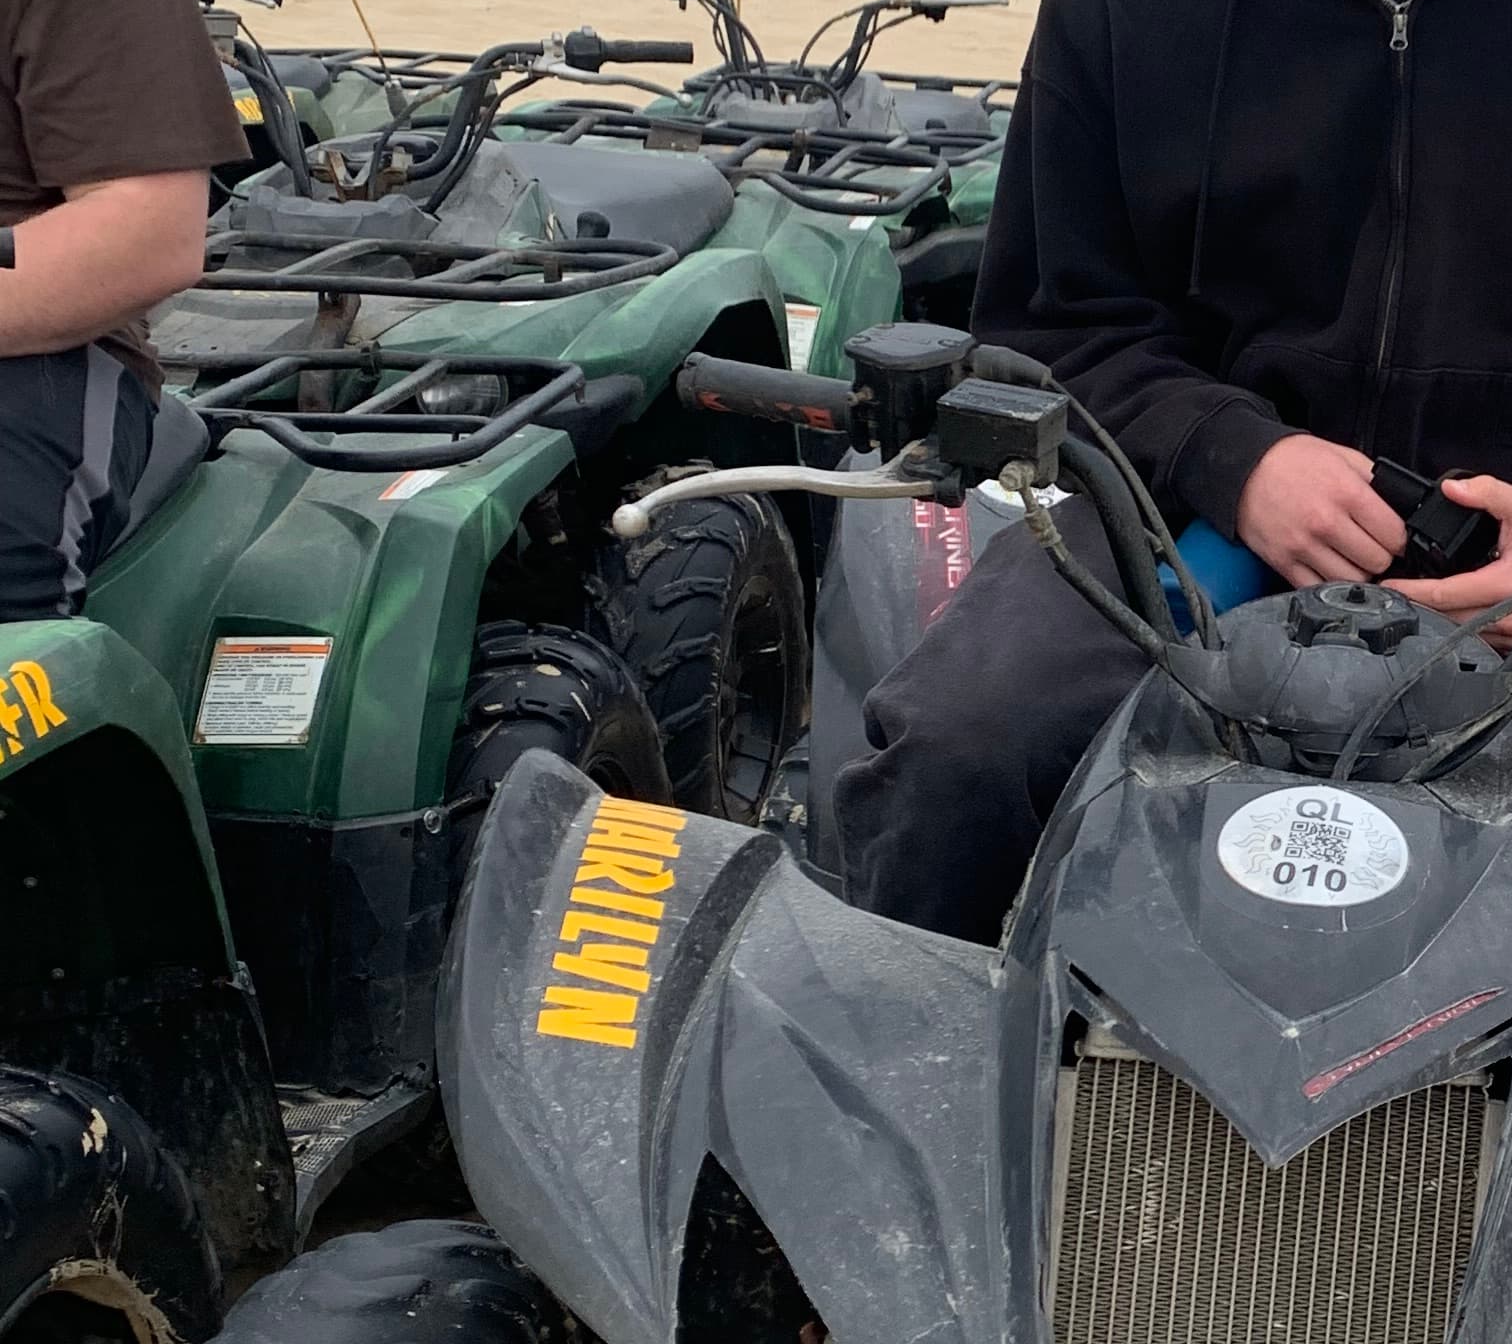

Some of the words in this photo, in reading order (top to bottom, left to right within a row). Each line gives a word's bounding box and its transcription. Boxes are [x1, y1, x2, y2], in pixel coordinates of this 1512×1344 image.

[1296, 799, 1354, 826] QL
[1273, 862, 1347, 892] 010
[536, 794, 688, 1048] MARILYN
